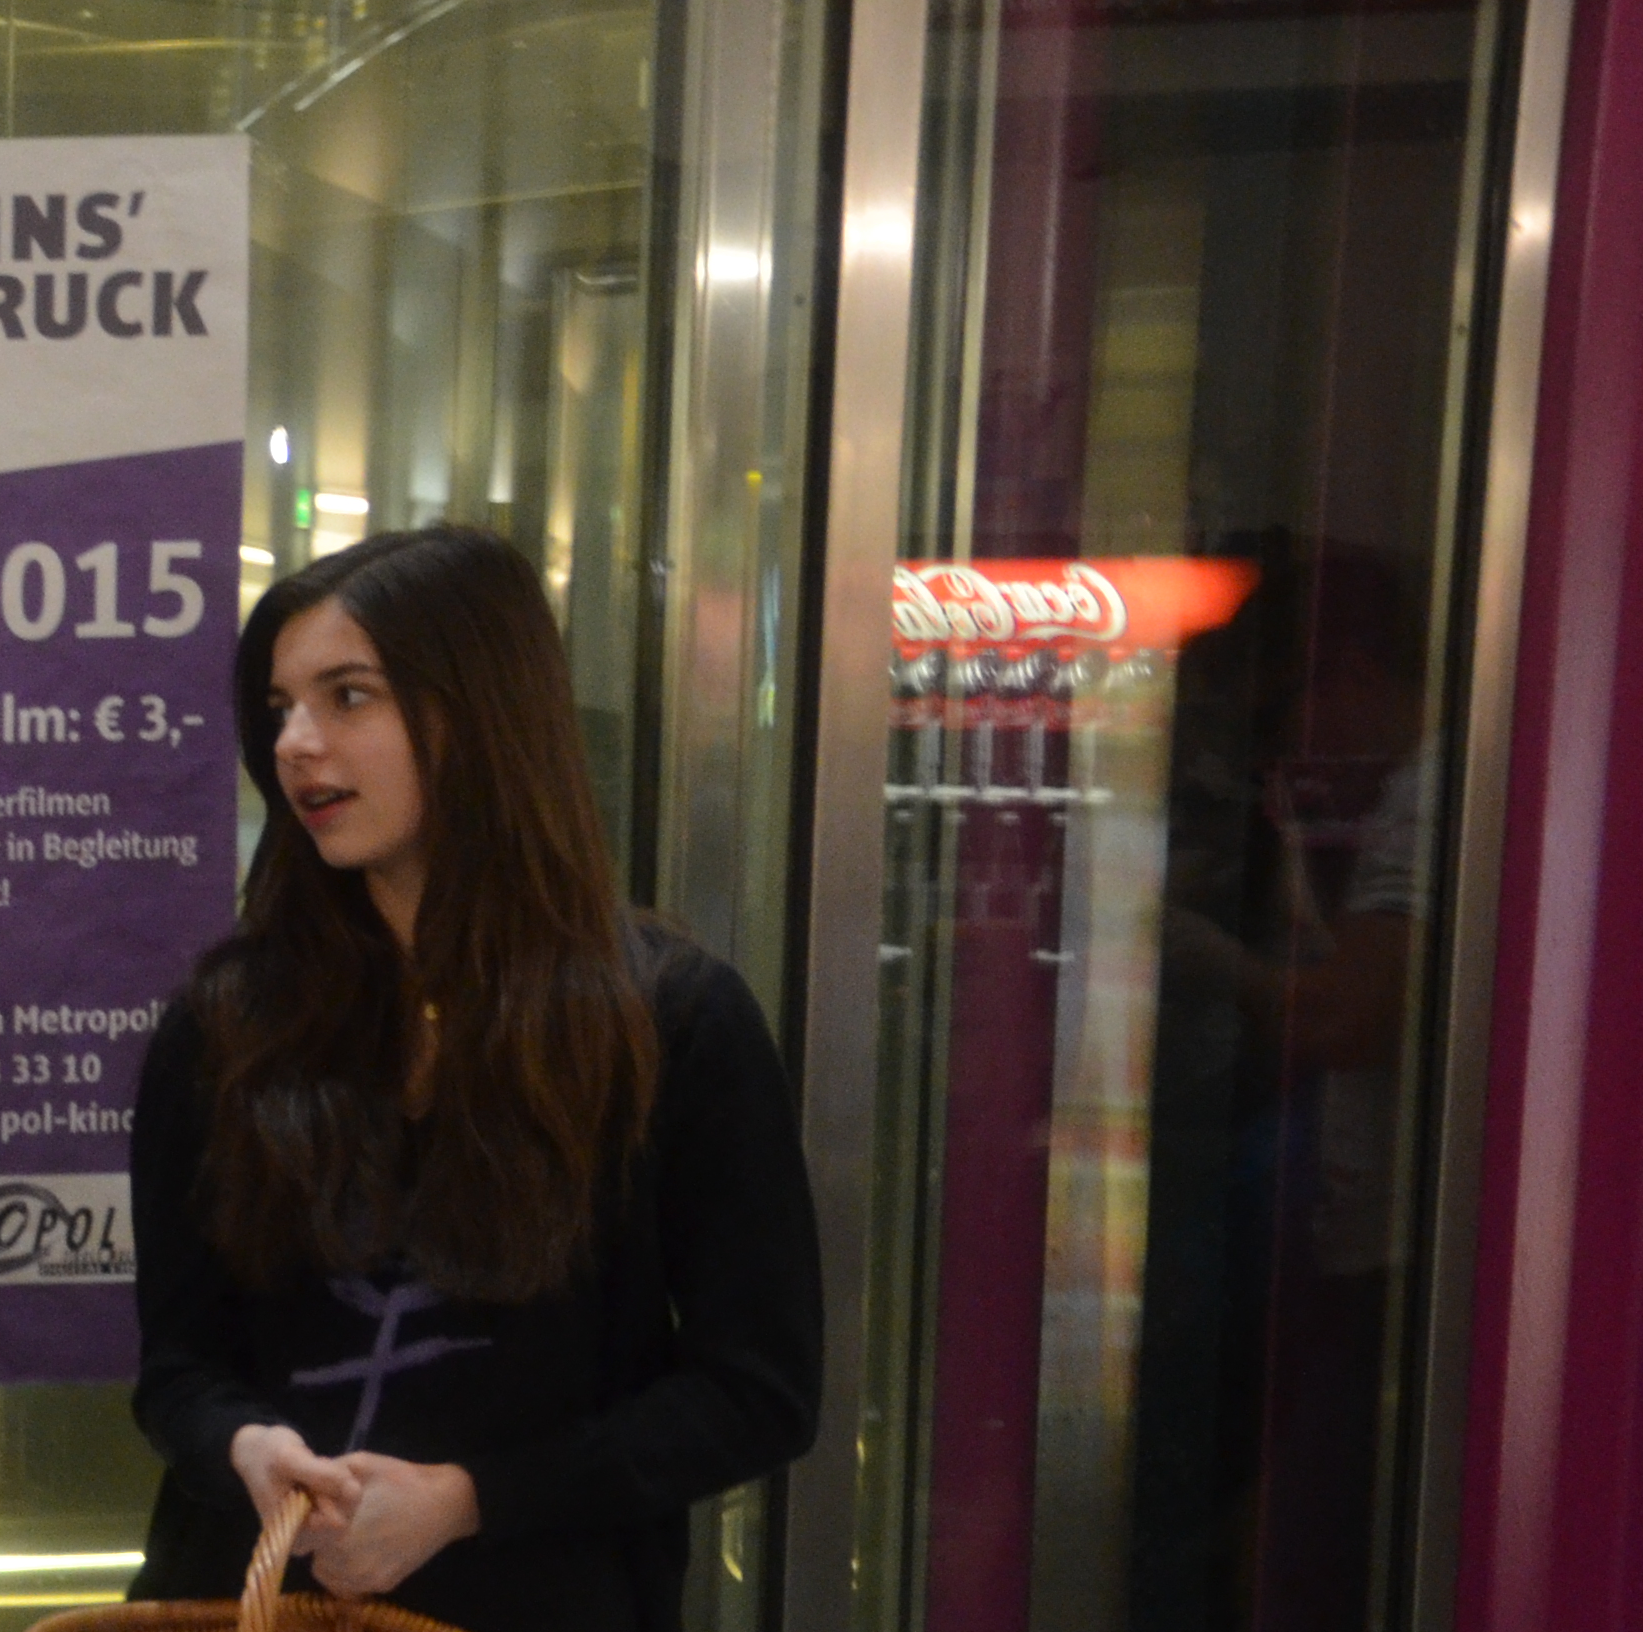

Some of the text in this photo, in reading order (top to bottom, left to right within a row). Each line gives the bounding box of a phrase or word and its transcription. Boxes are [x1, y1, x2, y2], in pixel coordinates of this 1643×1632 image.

[93, 695, 125, 742] €
[7, 832, 35, 863] in
[42, 829, 199, 868] Begleitung
[12, 1053, 51, 1085] 33
[63, 1053, 103, 1084] 10
